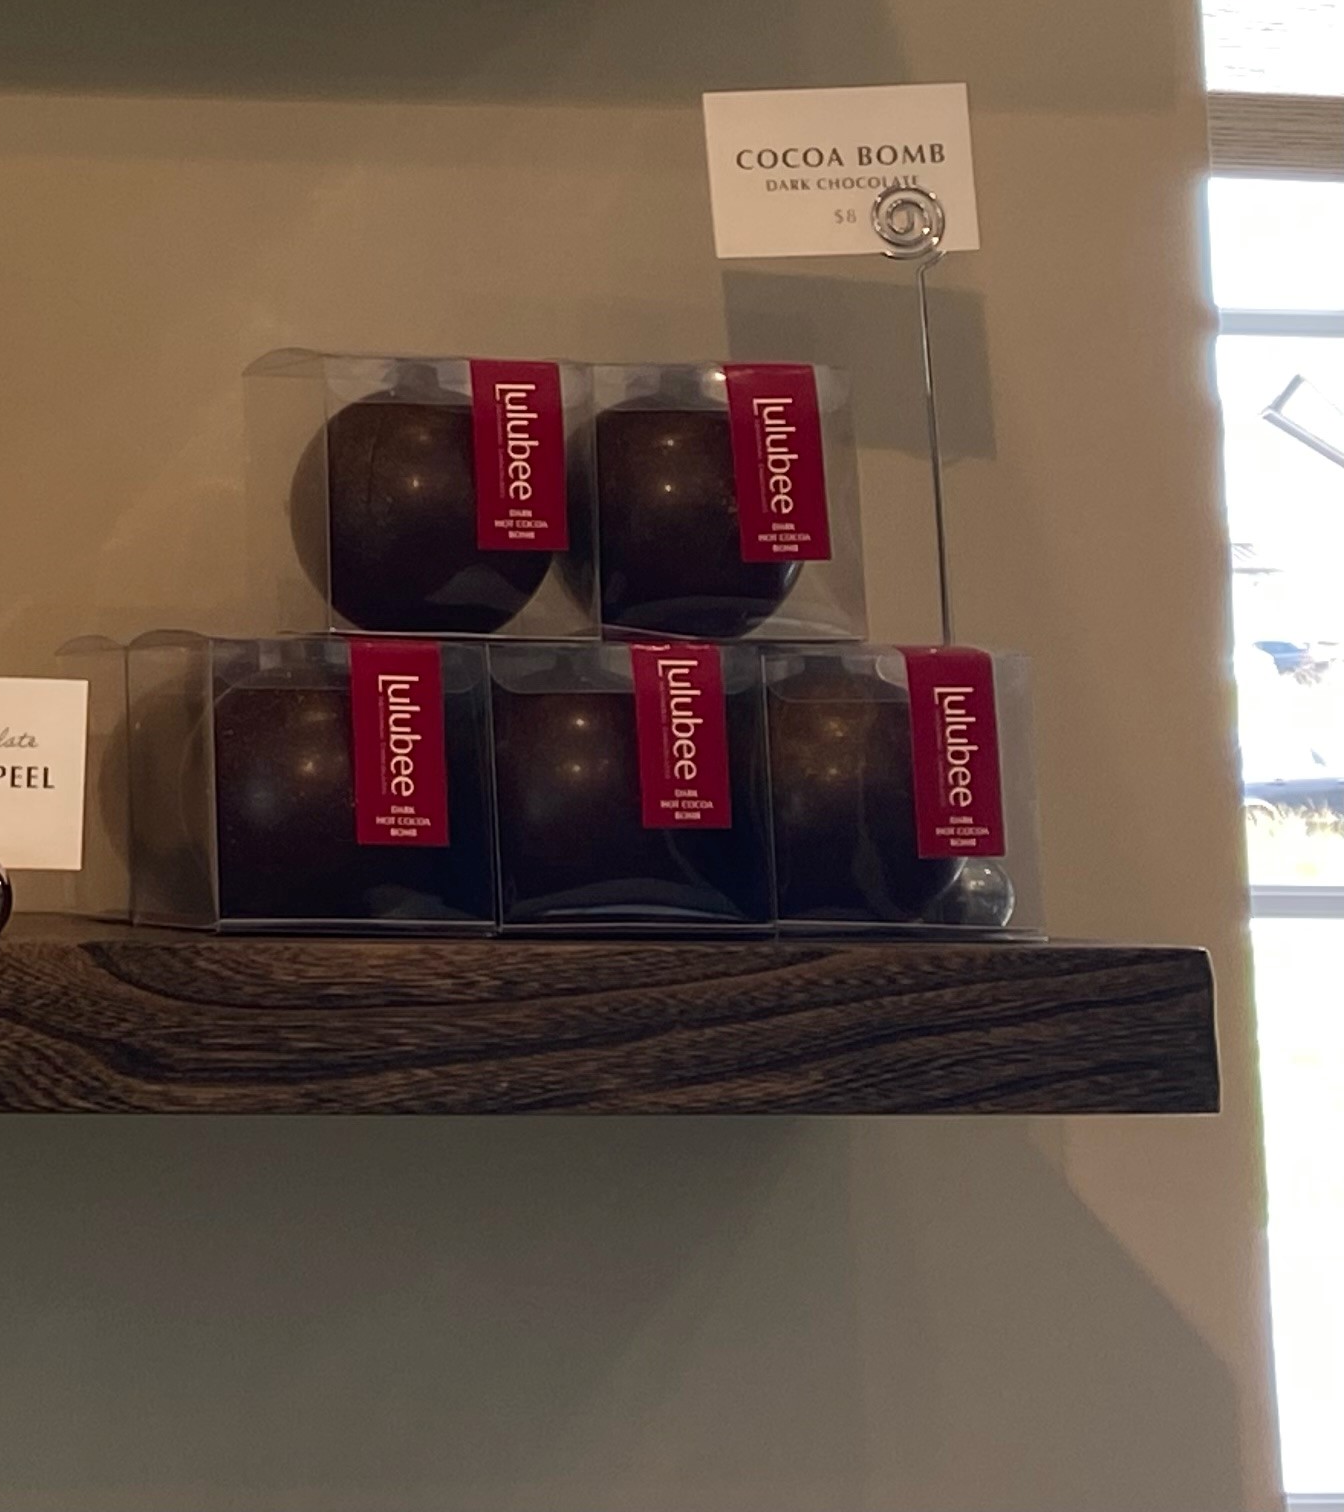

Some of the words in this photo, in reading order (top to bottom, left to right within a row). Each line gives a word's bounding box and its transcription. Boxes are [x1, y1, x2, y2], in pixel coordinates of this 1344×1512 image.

[736, 147, 844, 170] COCOA
[857, 143, 945, 166] BOMB
[765, 178, 811, 192] DARK
[816, 175, 919, 191] CHOCOLATE
[834, 208, 857, 225] $8
[495, 384, 539, 500] Lulubee
[753, 398, 798, 514] Lulubee
[378, 675, 422, 797] Lulubee
[658, 660, 703, 780] Lulubee
[934, 687, 979, 807] Lulubee
